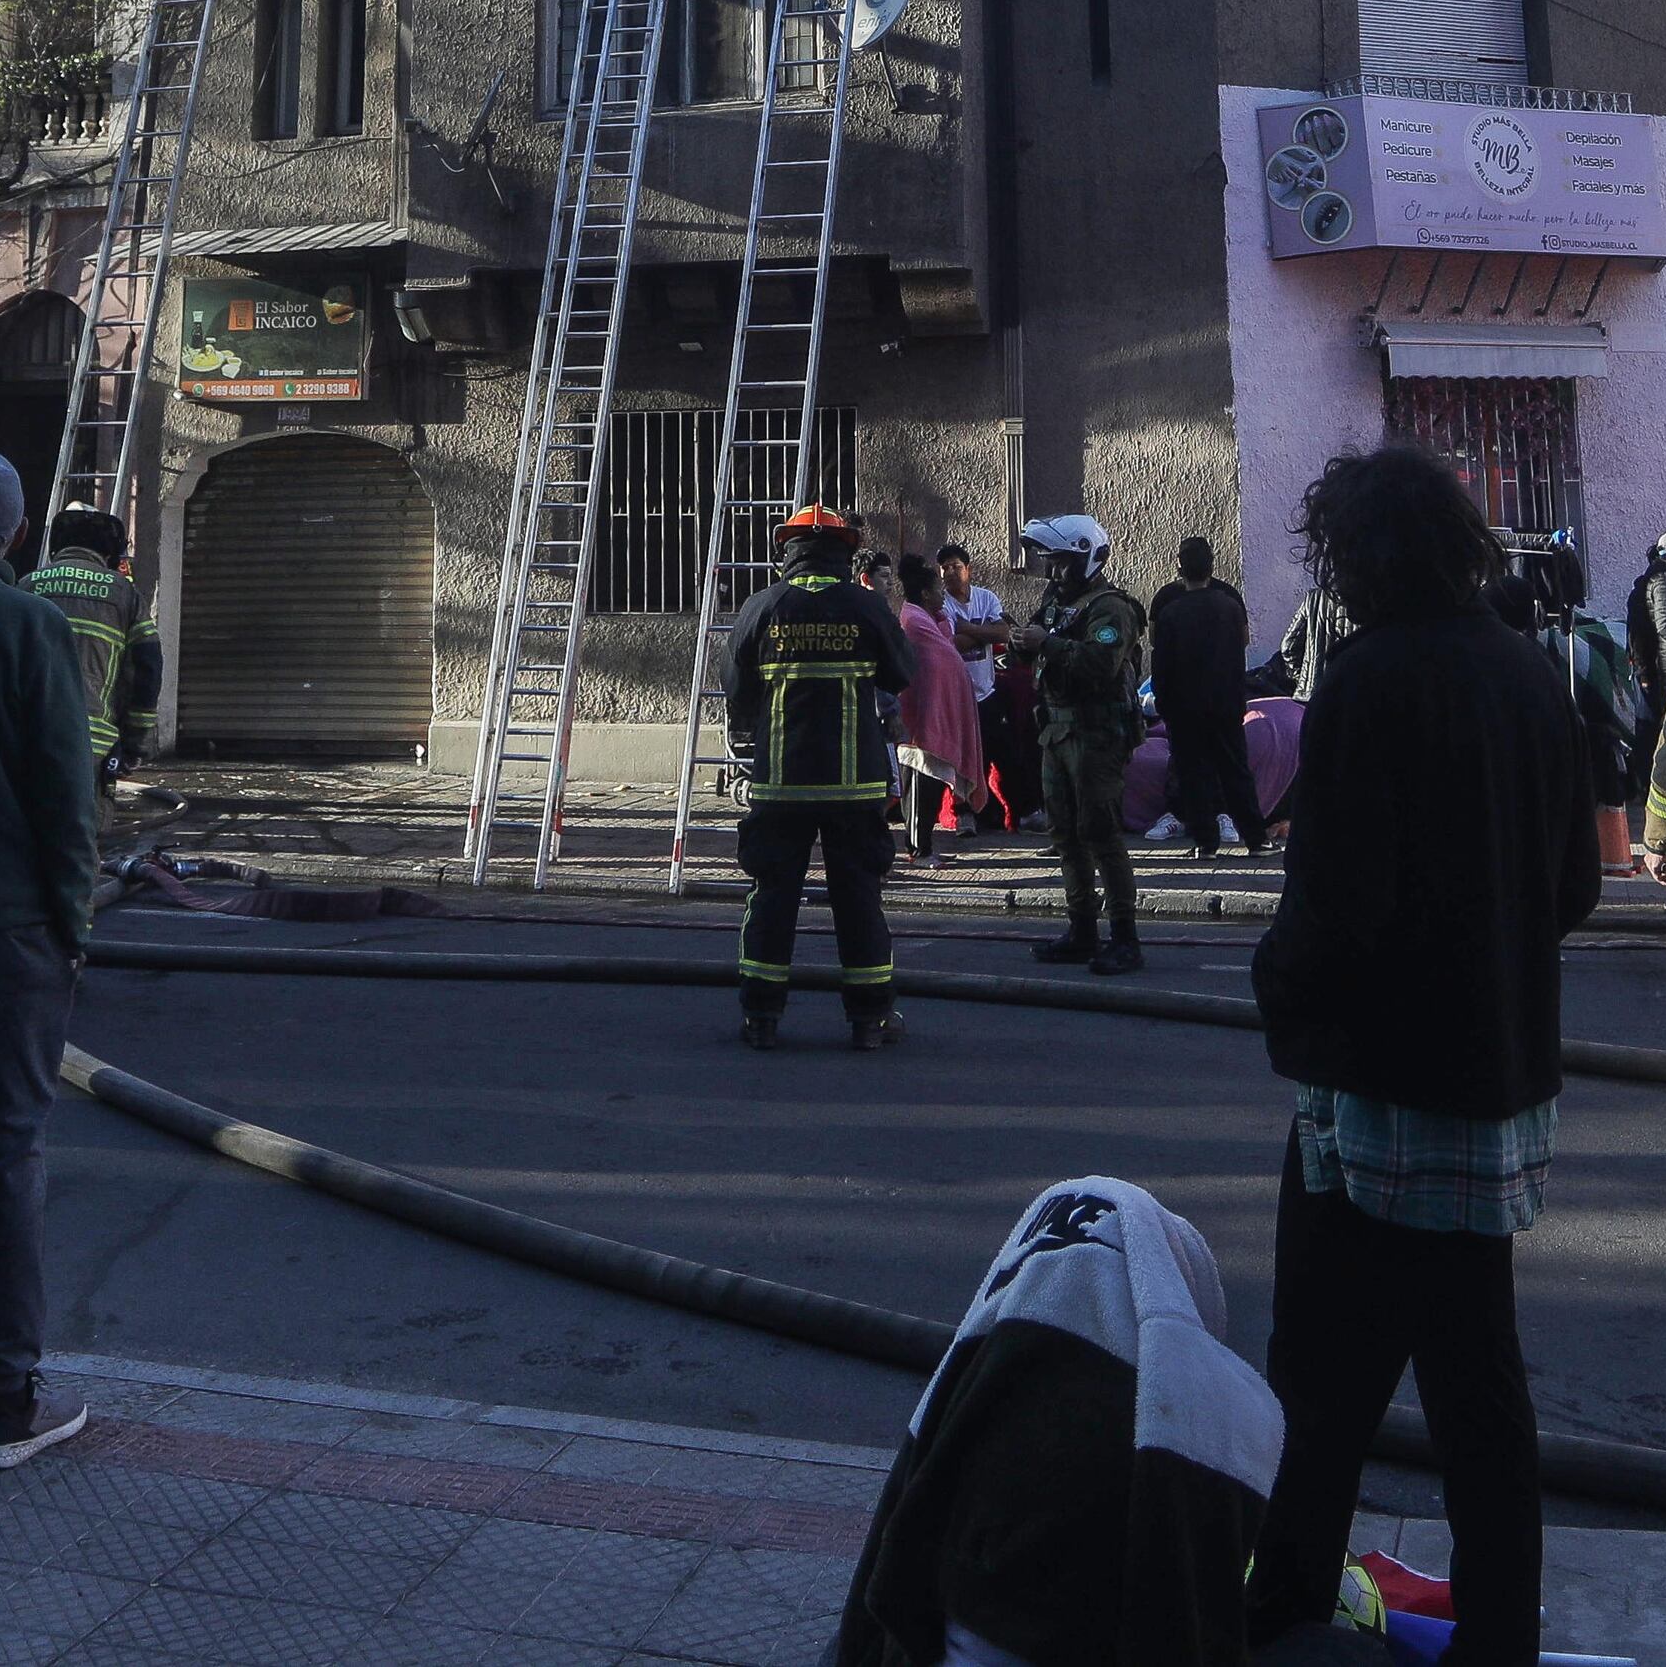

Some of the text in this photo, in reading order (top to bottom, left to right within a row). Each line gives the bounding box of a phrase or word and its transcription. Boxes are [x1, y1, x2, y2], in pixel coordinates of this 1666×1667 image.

[1380, 118, 1432, 134] Manicure
[1471, 115, 1534, 153] STUDIO MÁS BELLA
[1566, 131, 1622, 147] Depilación
[1382, 142, 1432, 158] Pedicure
[1572, 155, 1615, 170] Masajes
[1386, 169, 1437, 185] Pestañas
[1473, 161, 1535, 196] BELLEZA INTEGRAL
[1572, 179, 1646, 196] Faciales y más
[1444, 207, 1471, 224] puede
[1477, 206, 1504, 221] hacer
[1544, 215, 1565, 228] pero
[1569, 210, 1581, 225] la
[1585, 211, 1615, 232] belleza
[255, 300, 309, 315] El Sabor
[255, 314, 317, 330] INCAICO
[296, 383, 302, 395] 2
[30, 565, 115, 584] BOMBEROS
[34, 580, 109, 599] SANTIAGO
[769, 622, 861, 639] BOMBEROS
[775, 637, 855, 652] SANTIAGO
[107, 757, 119, 771] 9
